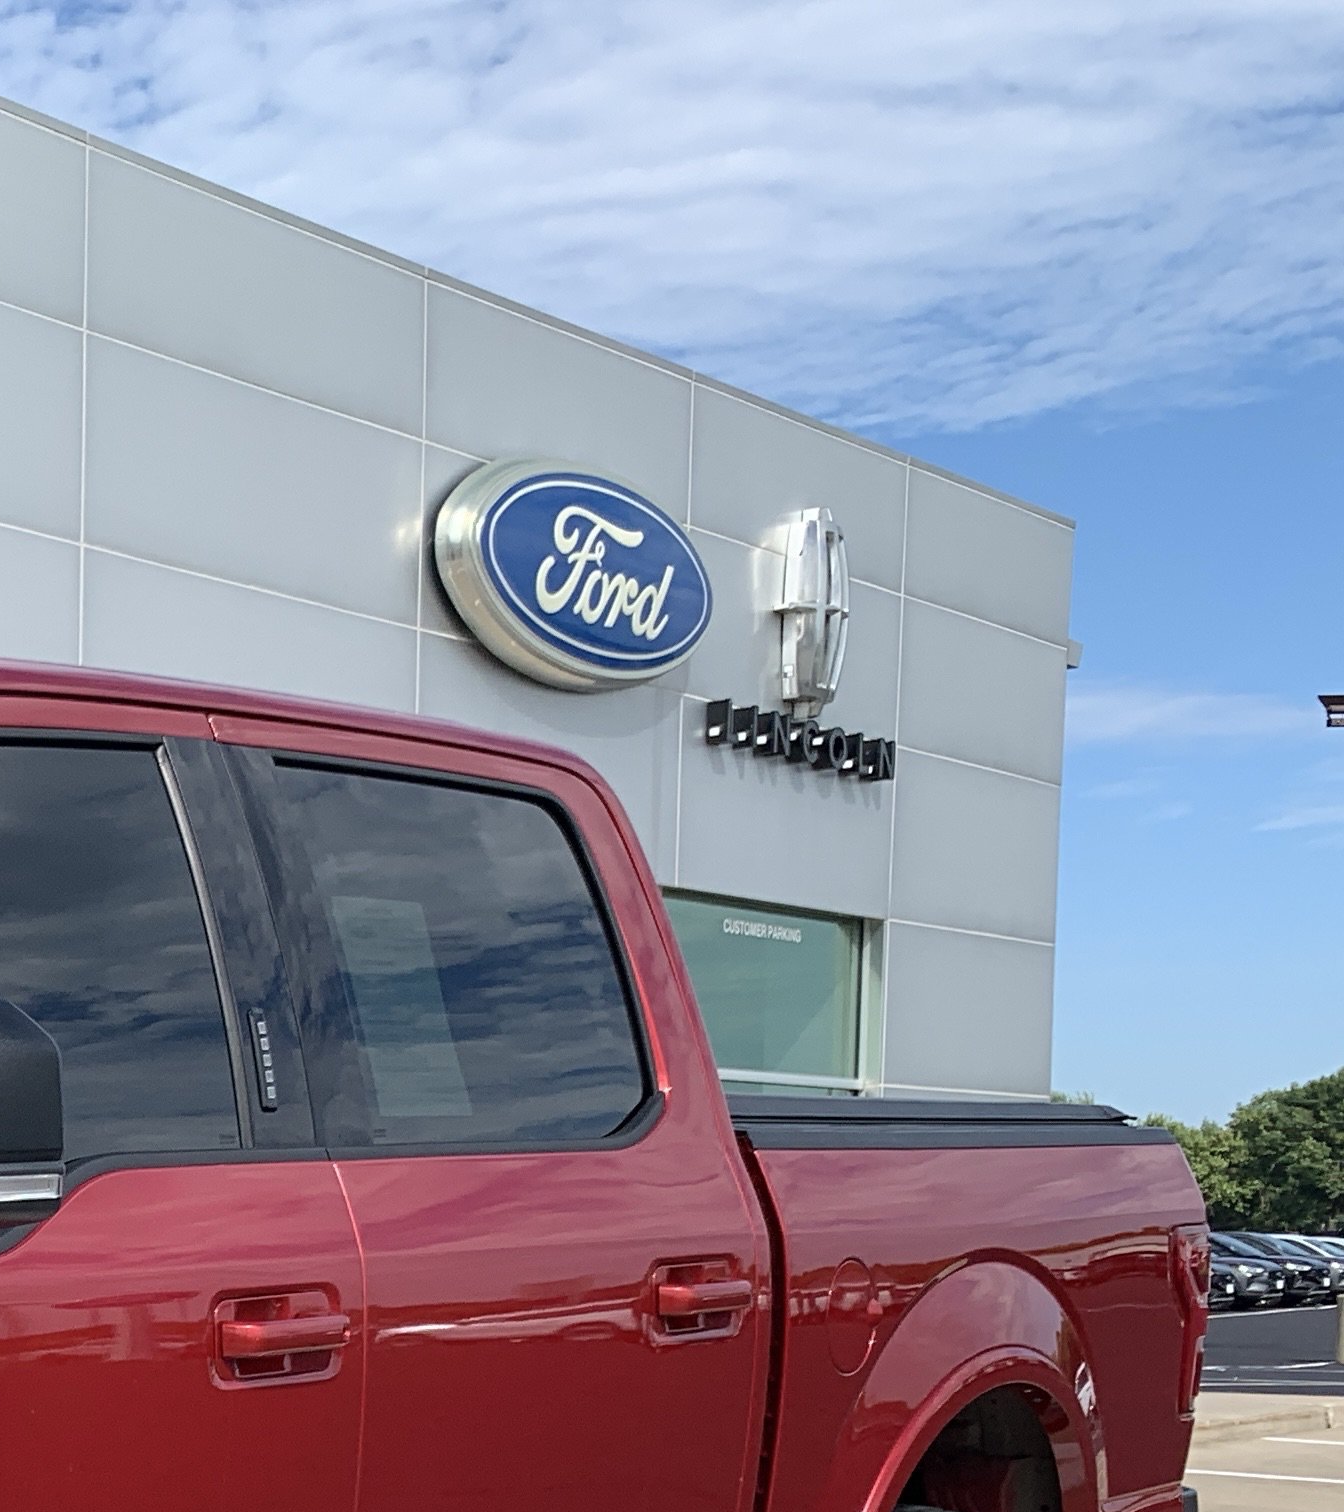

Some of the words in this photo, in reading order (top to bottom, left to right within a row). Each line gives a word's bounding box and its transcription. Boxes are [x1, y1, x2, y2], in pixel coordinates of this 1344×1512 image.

[535, 505, 675, 642] Ford
[706, 698, 897, 782] LINCOLN
[722, 918, 767, 938] CUSTOMER
[767, 924, 802, 943] PARKING
